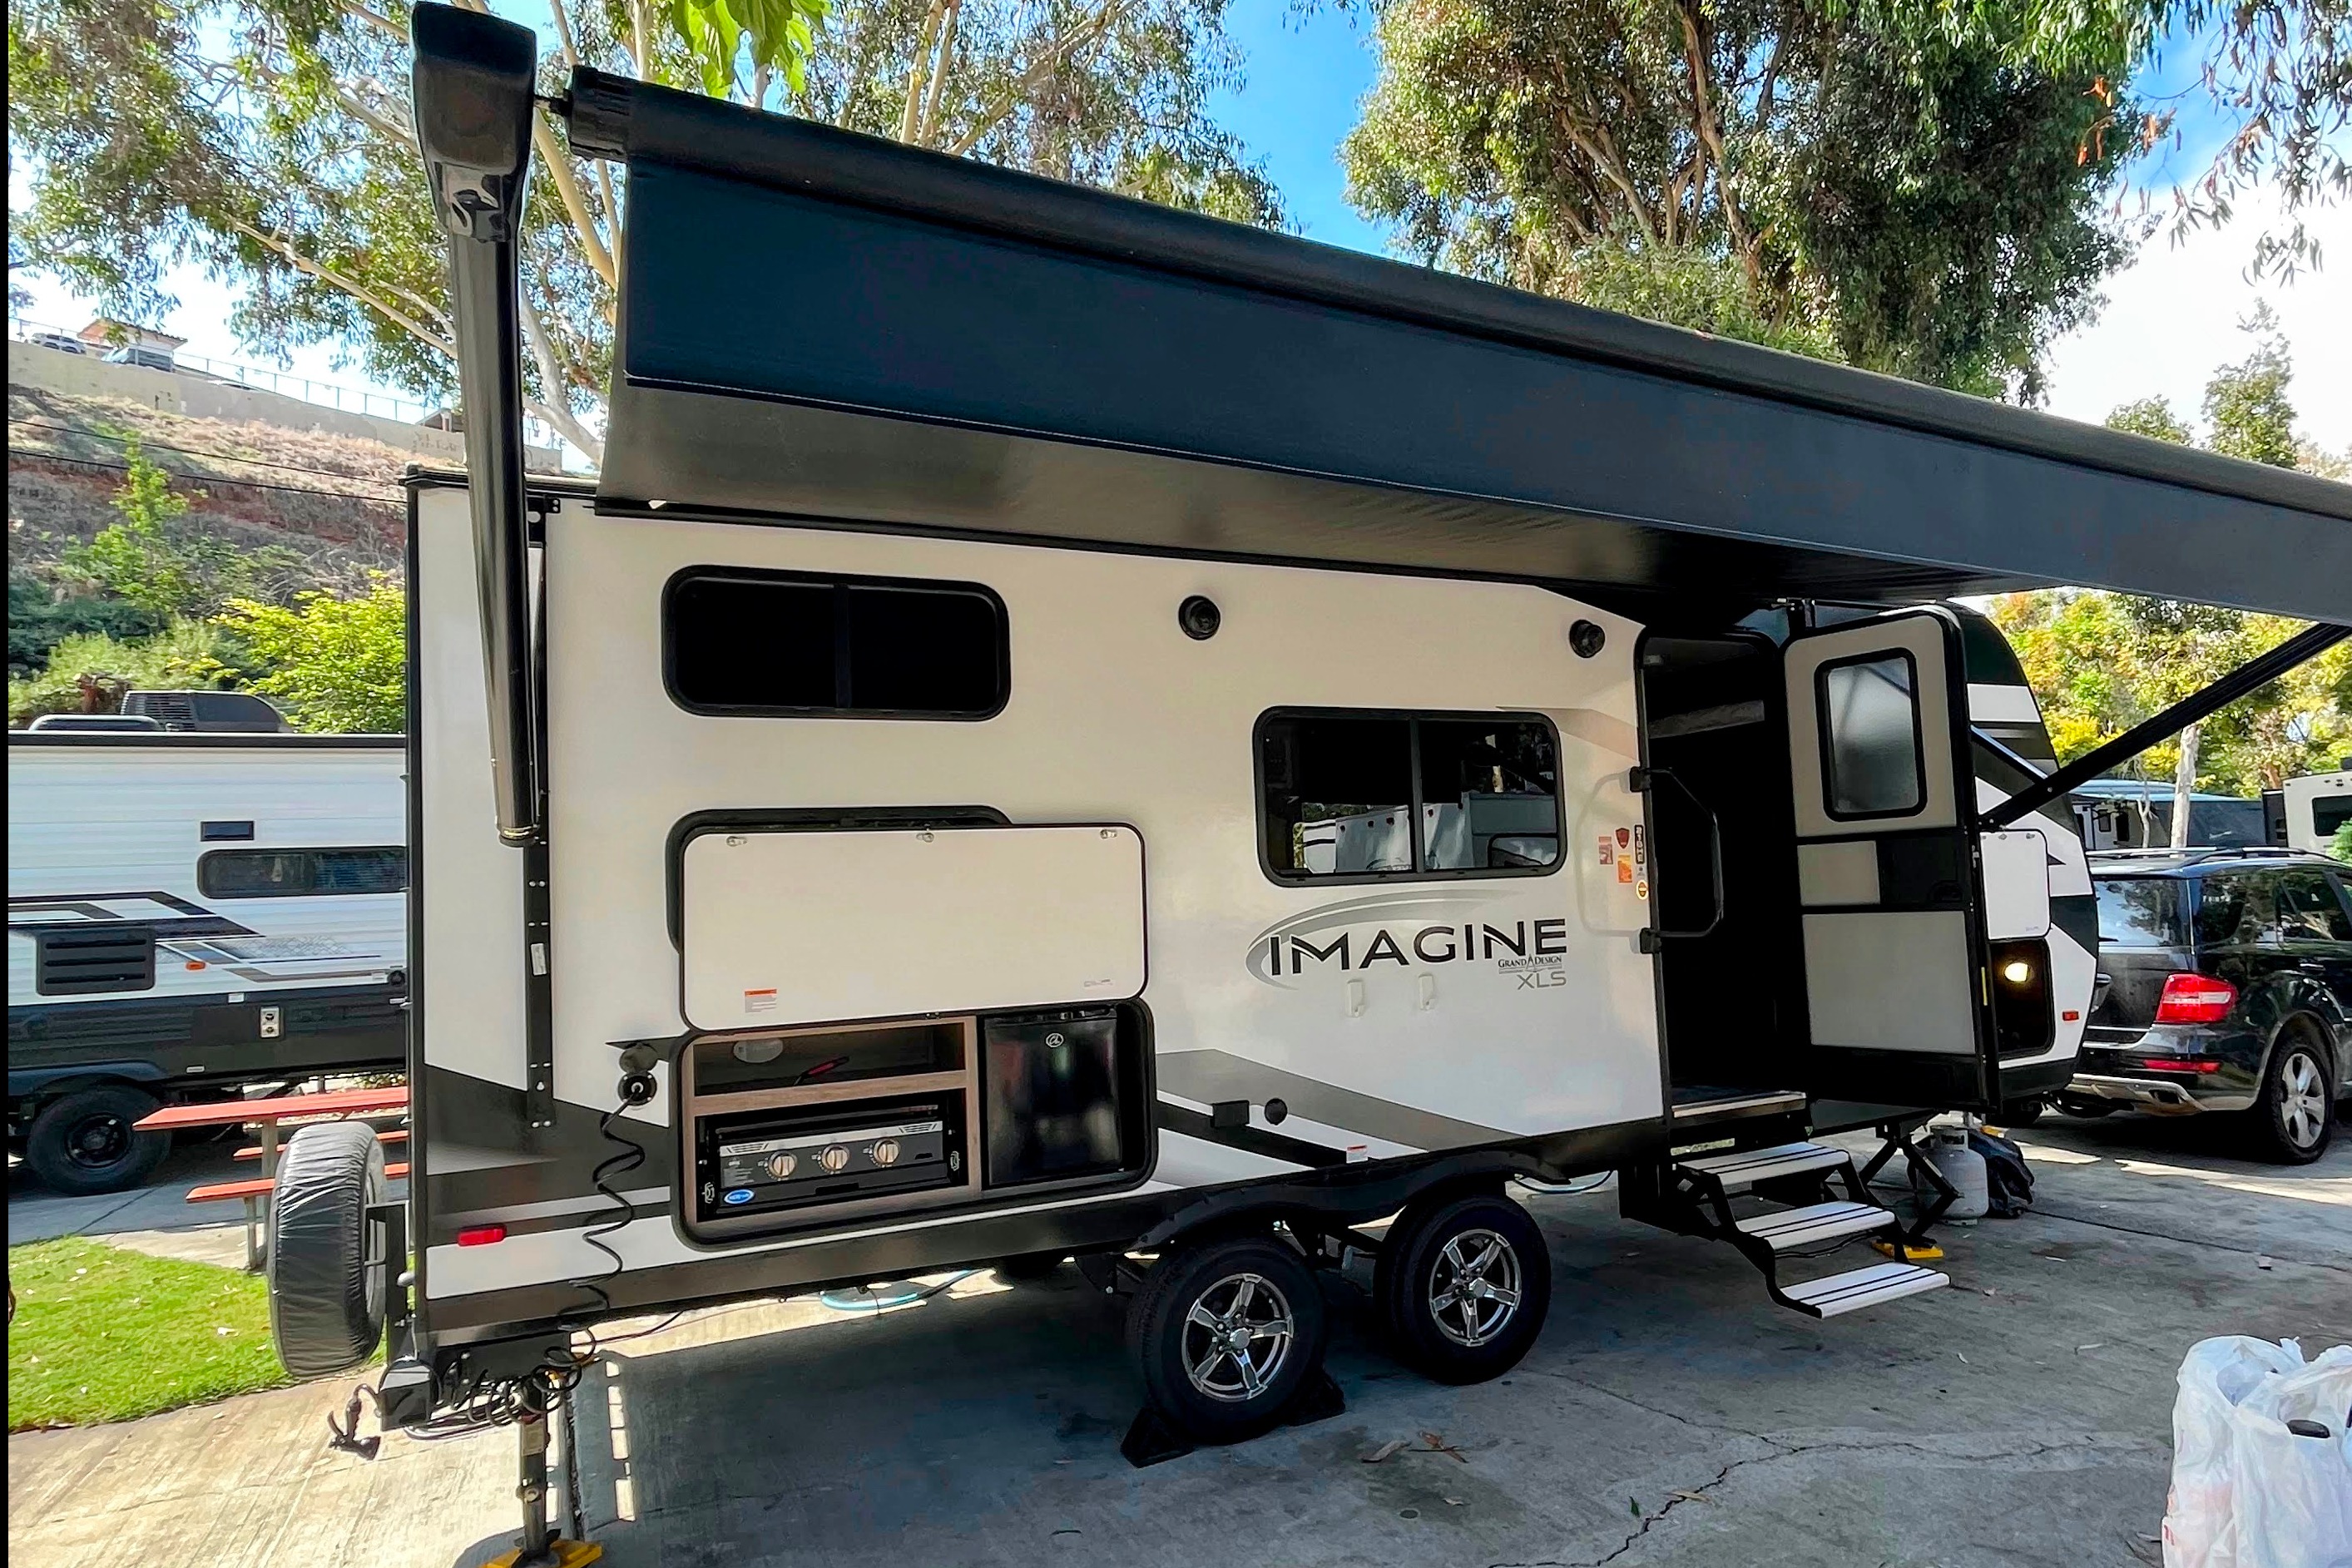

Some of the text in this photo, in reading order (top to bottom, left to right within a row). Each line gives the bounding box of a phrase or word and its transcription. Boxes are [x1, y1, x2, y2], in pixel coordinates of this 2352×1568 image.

[1270, 918, 1567, 976] IMAGINE
[1498, 955, 1562, 968] GRAND DESIGN
[1517, 971, 1567, 990] XLS
